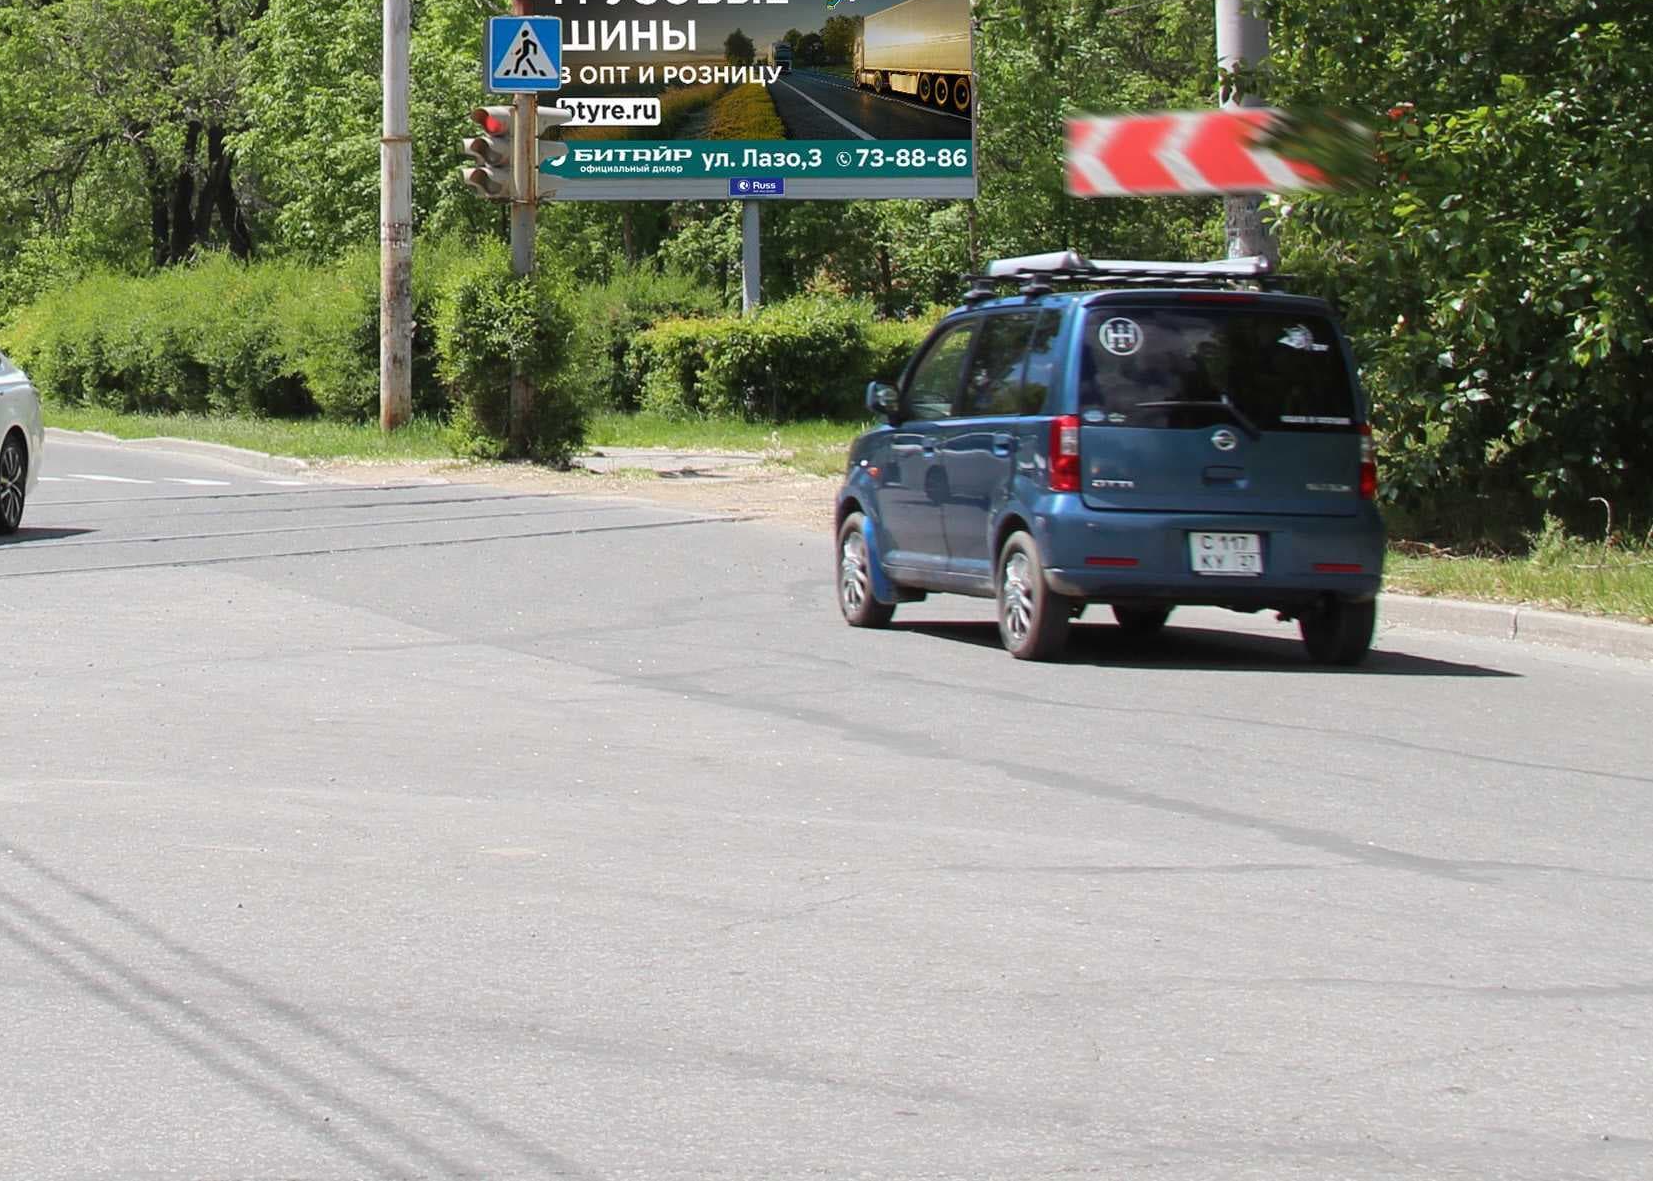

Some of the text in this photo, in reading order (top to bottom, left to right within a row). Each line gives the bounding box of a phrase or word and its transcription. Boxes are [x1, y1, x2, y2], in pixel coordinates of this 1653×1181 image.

[561, 19, 697, 52] ШИНЫ
[579, 65, 631, 85] ОПТ
[638, 66, 655, 85] И
[663, 65, 783, 88] РОЗНИЦУ
[573, 145, 693, 162] БИТАЙР
[701, 148, 822, 171] ул. Лазо,3
[855, 148, 968, 168] 73-88-86
[580, 163, 684, 174] официальный дилер
[752, 181, 776, 190] Russ
